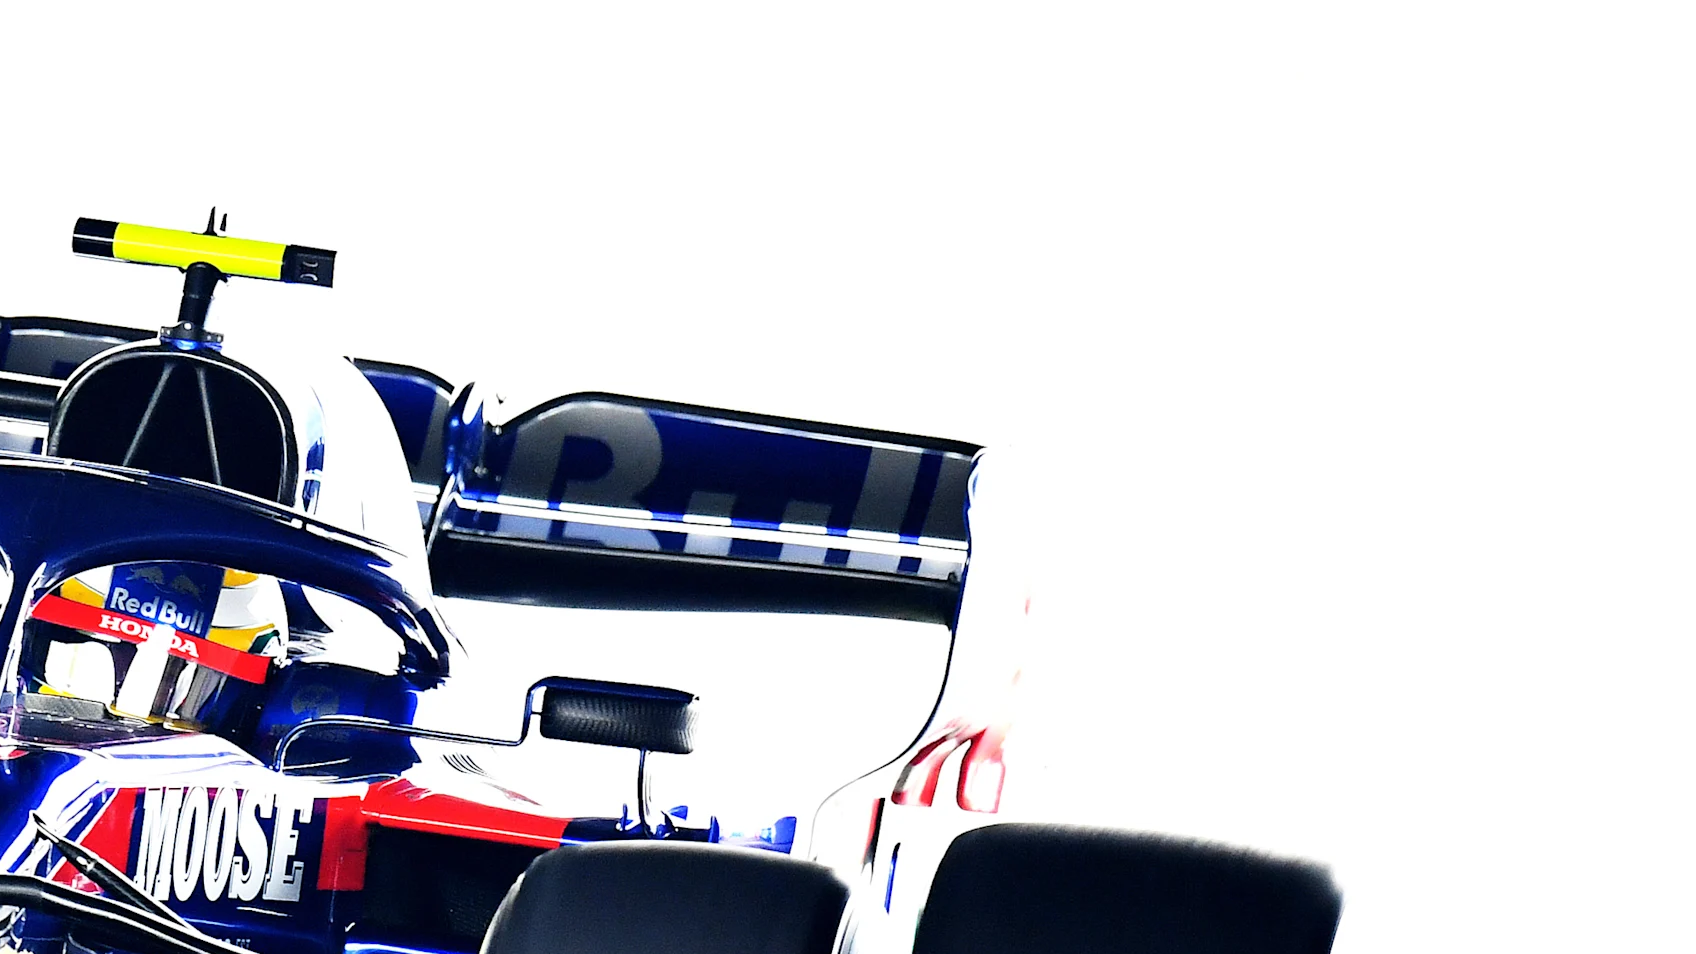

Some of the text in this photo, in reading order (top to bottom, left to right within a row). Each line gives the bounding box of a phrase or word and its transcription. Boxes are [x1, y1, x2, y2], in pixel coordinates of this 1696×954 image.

[110, 586, 204, 634] Red Bull
[133, 786, 314, 902] MOOSE
